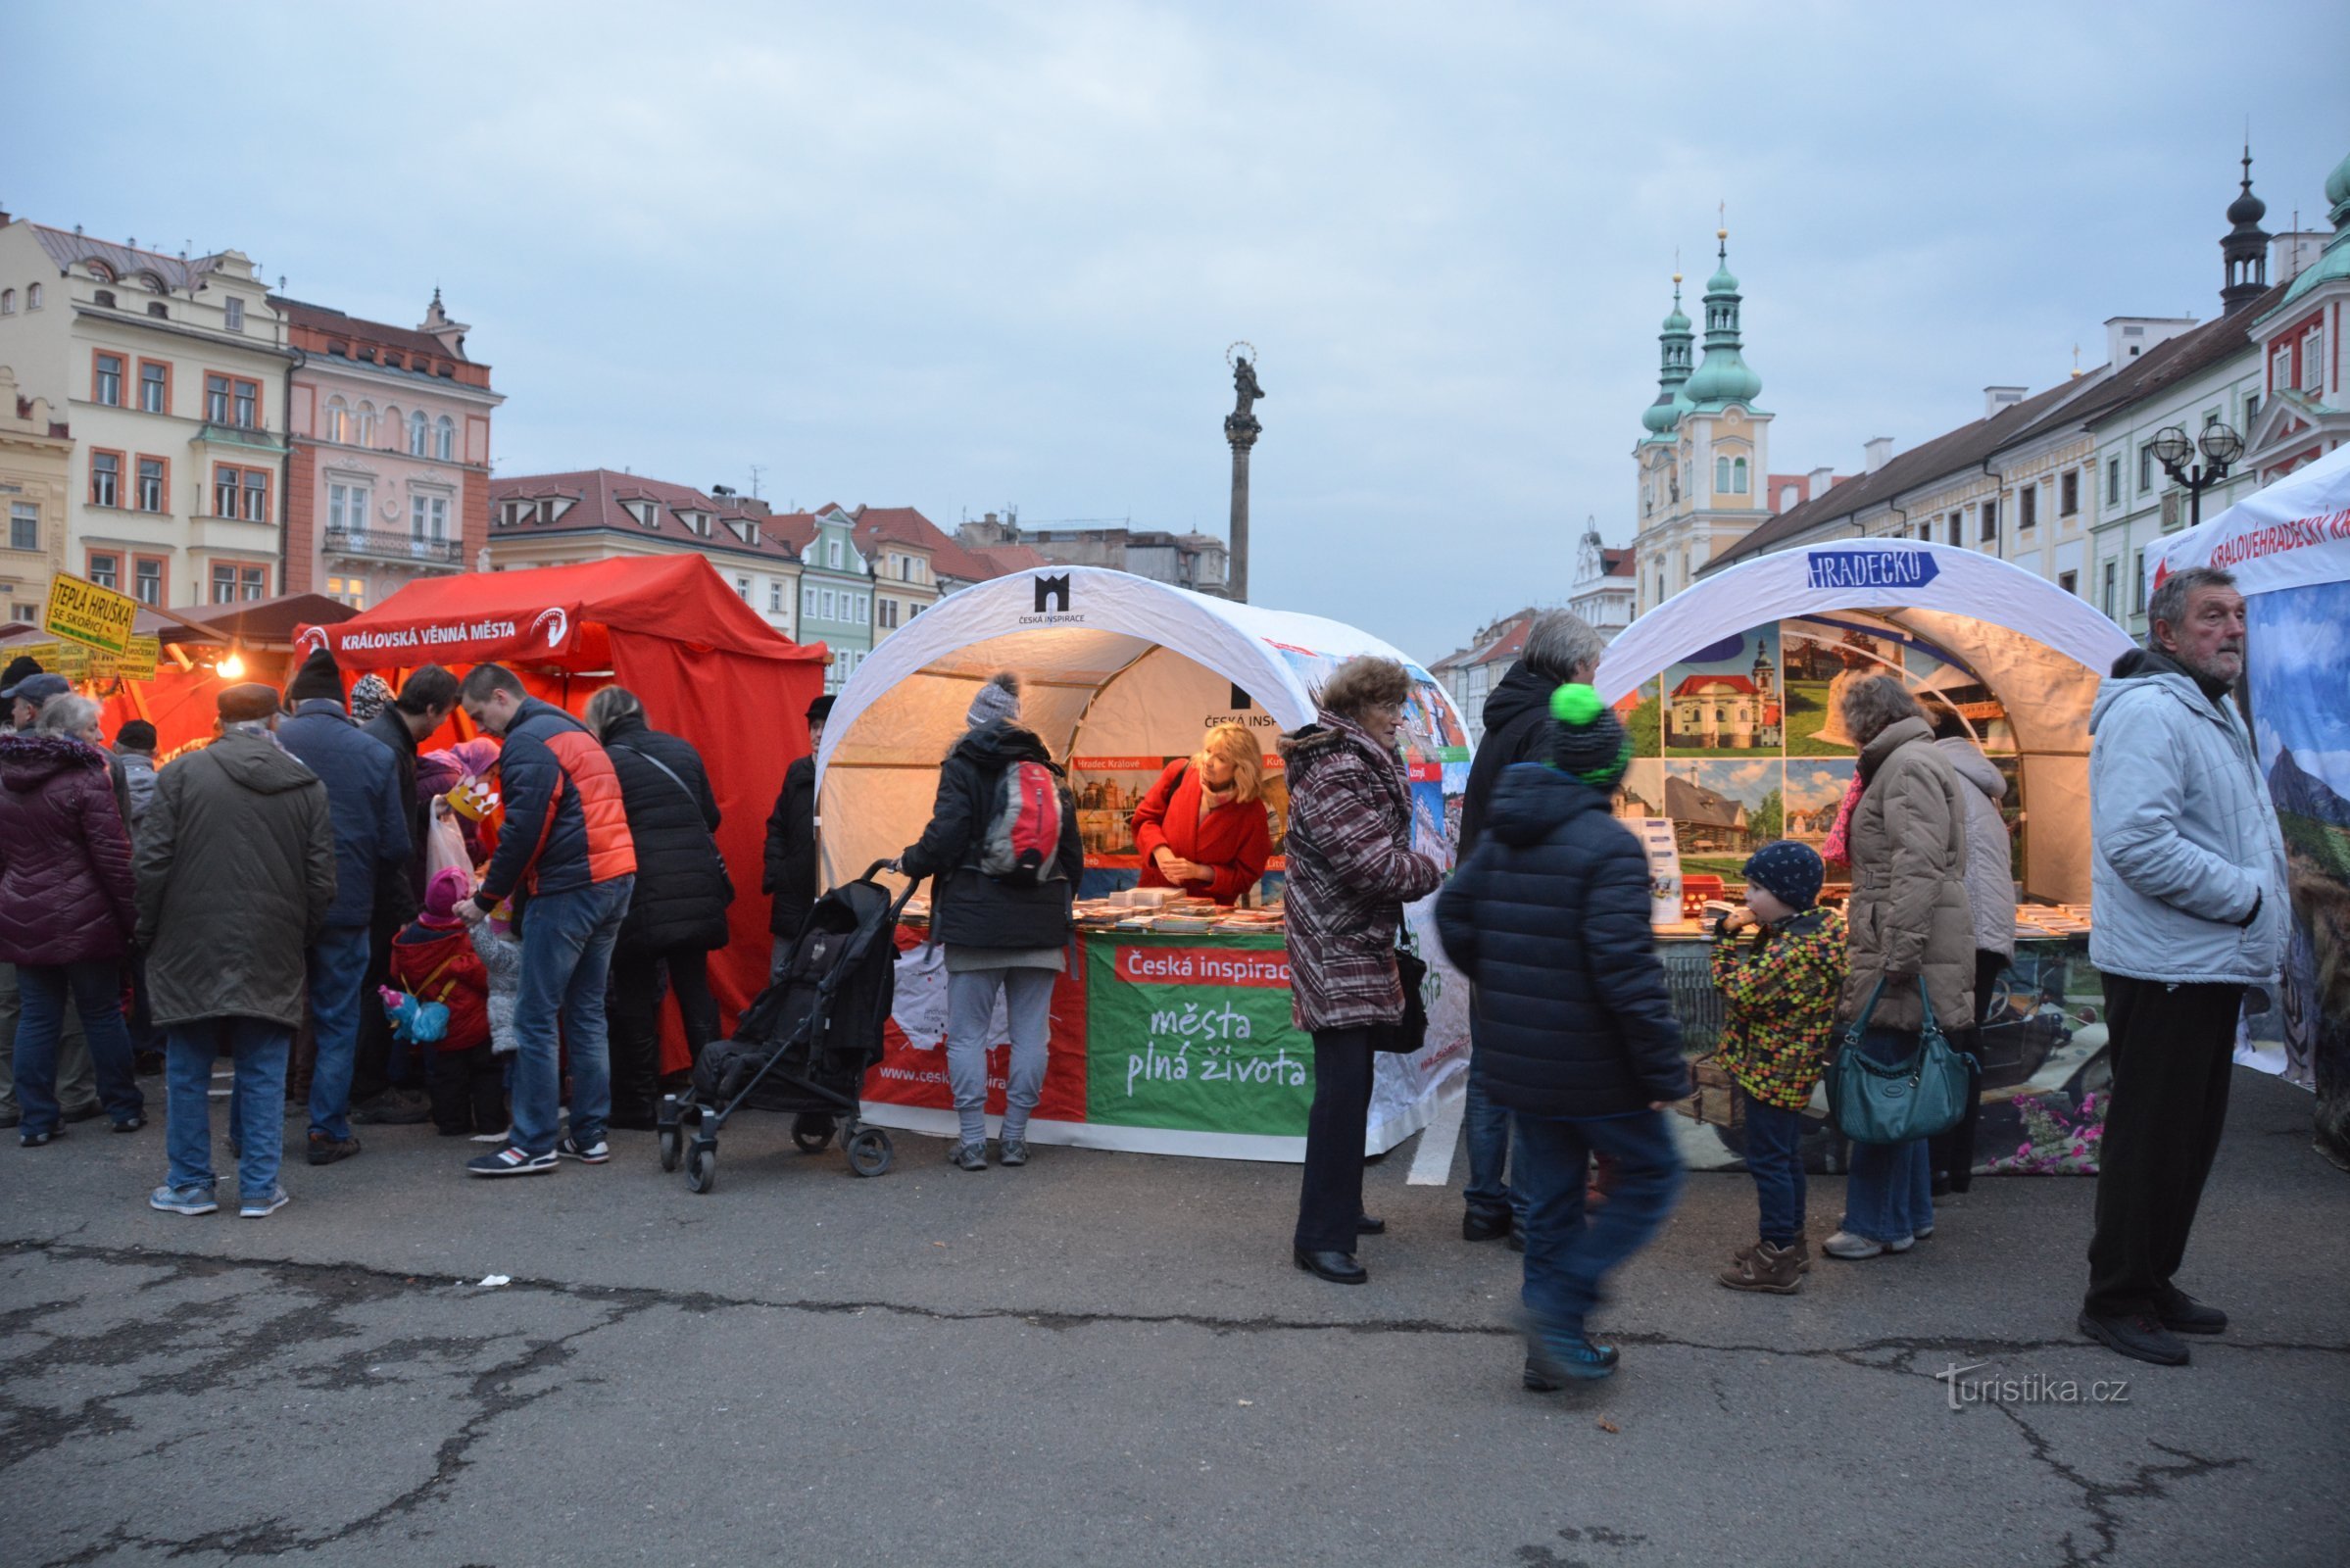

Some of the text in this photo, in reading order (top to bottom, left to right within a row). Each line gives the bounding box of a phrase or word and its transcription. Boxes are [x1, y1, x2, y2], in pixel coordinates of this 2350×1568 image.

[53, 608, 65, 620] SE
[56, 583, 130, 627] TEPLÁ HRUŠKA
[1019, 614, 1085, 624] ČESKÁ INSPIRACE
[342, 620, 515, 651] KRÁLOVSKÁ VĚNNÁ MĚSTA
[1077, 760, 1140, 768] Hradec Králové
[1128, 950, 1193, 977] Česká
[1151, 1001, 1251, 1041] města
[1127, 1040, 1306, 1098] plná života
